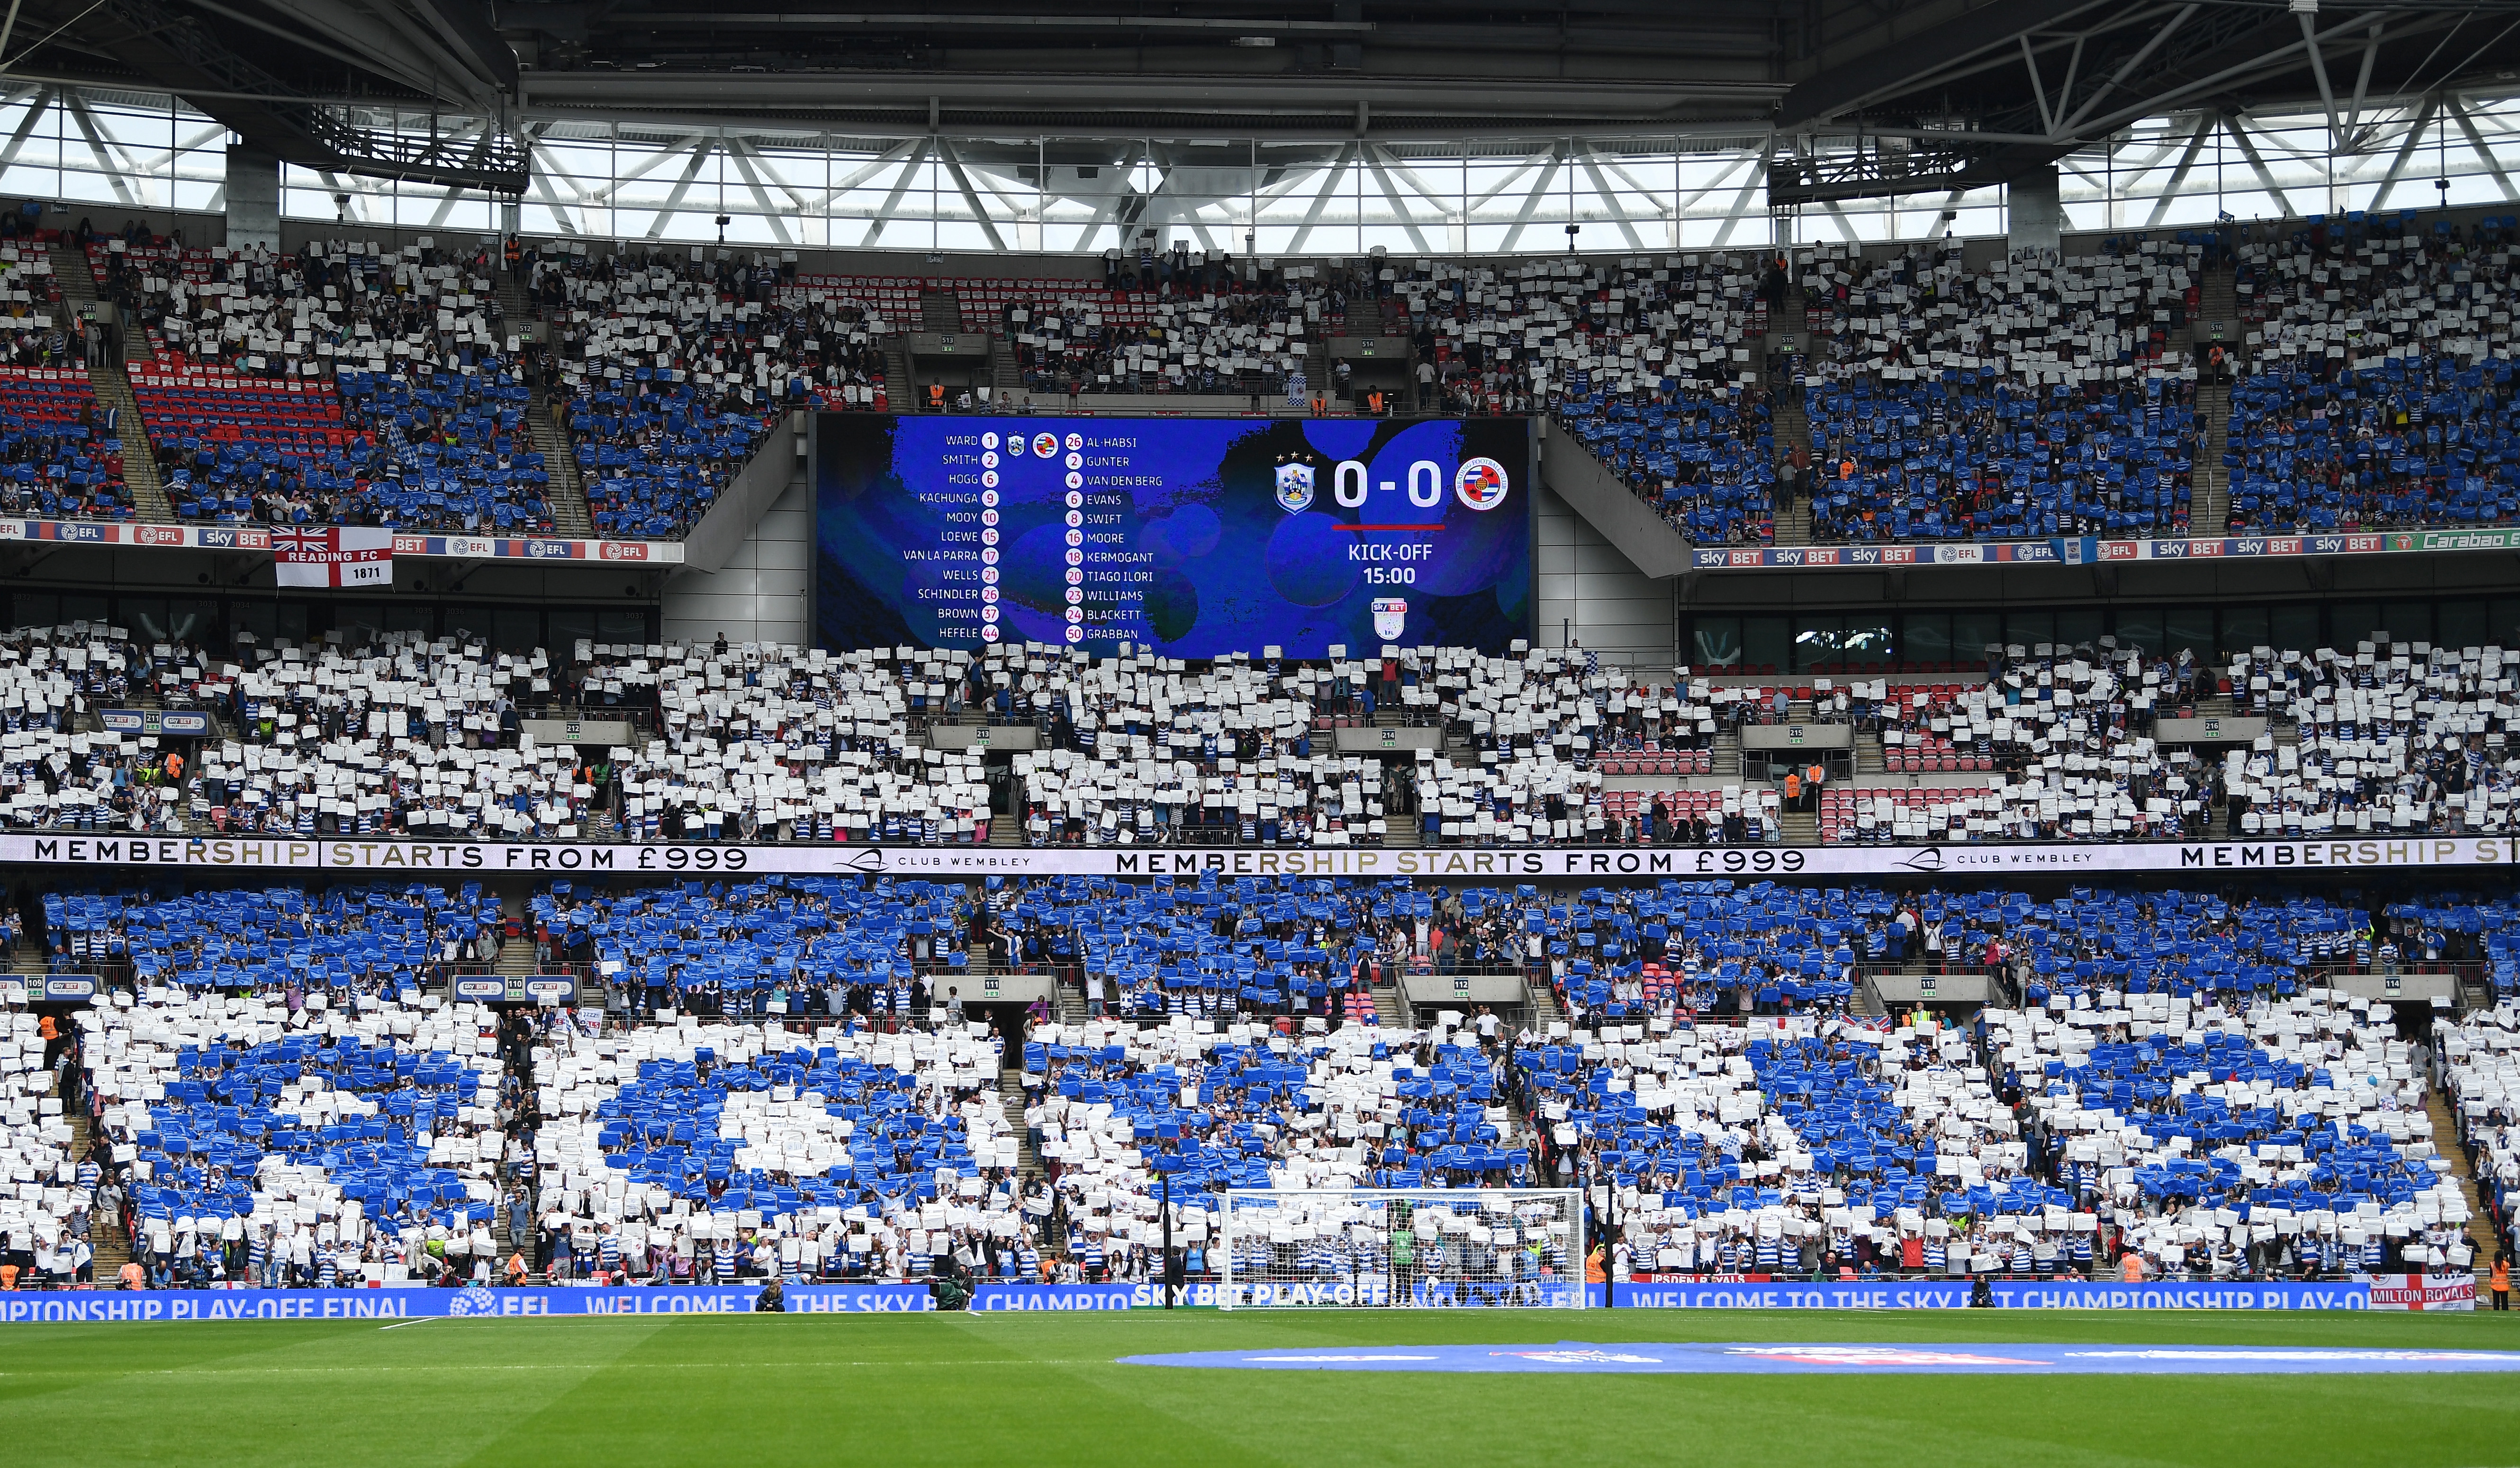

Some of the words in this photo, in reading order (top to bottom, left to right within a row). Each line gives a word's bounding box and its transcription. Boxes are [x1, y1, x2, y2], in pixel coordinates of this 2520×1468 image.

[946, 436, 977, 445] WARD
[988, 436, 992, 445] 1
[1068, 438, 1080, 446] 26
[1087, 438, 1136, 447] AL-HABSI
[943, 455, 977, 464] SMITH
[988, 455, 993, 464] 2
[1072, 457, 1077, 466] 2
[1087, 457, 1129, 466] GUNTER
[949, 474, 977, 484] HOGG
[987, 475, 993, 484] 6
[1457, 463, 1472, 489] READING
[1472, 459, 1501, 473] FOOTBALL
[1071, 476, 1077, 485] 4
[1087, 476, 1108, 485] VAN
[1111, 477, 1132, 486] DEN
[1136, 477, 1162, 486] BERG
[1335, 460, 1367, 507] 0
[1380, 482, 1395, 490] -
[1409, 460, 1441, 507] 0
[920, 493, 977, 503] KACHUNGA
[987, 494, 993, 503] 9
[1072, 495, 1077, 504] 6
[1088, 495, 1121, 504] EVANS
[947, 513, 977, 522] MOOY
[985, 513, 996, 522] 10
[1071, 514, 1077, 523] 8
[1087, 514, 1121, 523] SWIFT
[0, 524, 18, 534] EFL
[80, 528, 98, 537] EFL
[159, 531, 177, 541] EFL
[207, 531, 233, 547] sky
[240, 533, 267, 545] BET
[942, 531, 977, 541] LOEWE
[985, 532, 996, 541] 15
[1069, 533, 1080, 542] 16
[1088, 533, 1124, 543] MOORE
[2422, 532, 2504, 548] Carabao
[396, 539, 423, 551] BET
[470, 542, 488, 552] EFL
[547, 545, 565, 554] EFL
[2160, 541, 2185, 557] sky
[2193, 542, 2220, 554] BET
[2238, 540, 2263, 554] sky
[2271, 540, 2298, 552] BET
[2316, 537, 2342, 552] sky
[2349, 538, 2377, 549] BET
[289, 552, 352, 561] READING
[361, 549, 378, 559] FC
[624, 547, 641, 556] EFL
[904, 550, 924, 559] VAN
[928, 550, 940, 560] LA
[944, 551, 977, 560] PARRA
[985, 552, 995, 560] 17
[1349, 544, 1432, 560] KICK-OFF
[1959, 549, 1977, 558] EFL
[2035, 548, 2053, 557] EFL
[2113, 546, 2131, 555] EFL
[1069, 553, 1080, 561] 18
[1088, 552, 1153, 562] KERMOGANT
[1700, 551, 1725, 566] sky
[1733, 552, 1759, 563] BET
[1776, 551, 1801, 565] sky
[1809, 551, 1835, 562] BET
[1852, 550, 1878, 564] sky
[1885, 549, 1911, 561] BET
[353, 567, 380, 579] 1871
[943, 570, 977, 580] WELLS
[985, 571, 995, 580] 21
[1068, 572, 1081, 581] 20
[1087, 572, 1120, 581] TIAGO
[1124, 572, 1152, 581] ILORI
[1364, 568, 1415, 584] 15:00
[919, 589, 977, 599] SCHINDLER
[985, 590, 996, 599] 26
[1069, 591, 1081, 600] 23
[1087, 591, 1142, 601] WILLIAMS
[939, 609, 977, 618] BROWN
[985, 609, 996, 618] 37
[1068, 610, 1081, 619] 24
[1088, 610, 1141, 620] BLACKETT
[940, 628, 977, 638] HEFELE
[985, 629, 996, 638] 44
[1068, 630, 1081, 639] 50
[1087, 630, 1137, 639] GRABBAN
[567, 724, 580, 732] 212
[2206, 721, 2219, 730] 216
[35, 839, 309, 864] MEMBERSHIP
[332, 844, 483, 867] STARTS
[506, 848, 613, 868] FROM
[638, 847, 747, 870] £999
[2181, 840, 2456, 866] MEMBERSHIP
[898, 857, 941, 865] CLUB
[951, 858, 1030, 866] WEMBLEY
[1116, 852, 1378, 873] MEMBERSHIP
[1397, 852, 1543, 873] STARTS
[1566, 851, 1672, 873] FROM
[1696, 850, 1805, 873] £999
[1957, 856, 2000, 864] CLUB
[2011, 854, 2092, 864] WEMBLEY
[508, 980, 522, 988] 110
[985, 980, 998, 988] 111
[1454, 981, 1468, 989] 112
[1651, 1274, 1695, 1283] IPSDEN
[1700, 1275, 1744, 1283] RYALS
[1135, 1285, 1190, 1306] SKY
[1197, 1284, 1249, 1306] BET
[2426, 1286, 2473, 1301] ROYALS
[586, 1295, 735, 1313] WELCOME
[791, 1294, 847, 1313] THE
[857, 1294, 908, 1312] SKY
[994, 1294, 1137, 1309] CHAMPIO
[1633, 1292, 1778, 1307] WELCOME
[1786, 1291, 1823, 1307] TO
[1833, 1291, 1887, 1307] THE
[1897, 1291, 1951, 1307] SKY
[1961, 1291, 2014, 1307] BT
[2023, 1291, 2254, 1308] CHAMPIONSHIP
[2264, 1291, 2370, 1308] PLAY-O
[172, 1298, 314, 1319] PLAY-OFF
[324, 1297, 406, 1317] FINAL
